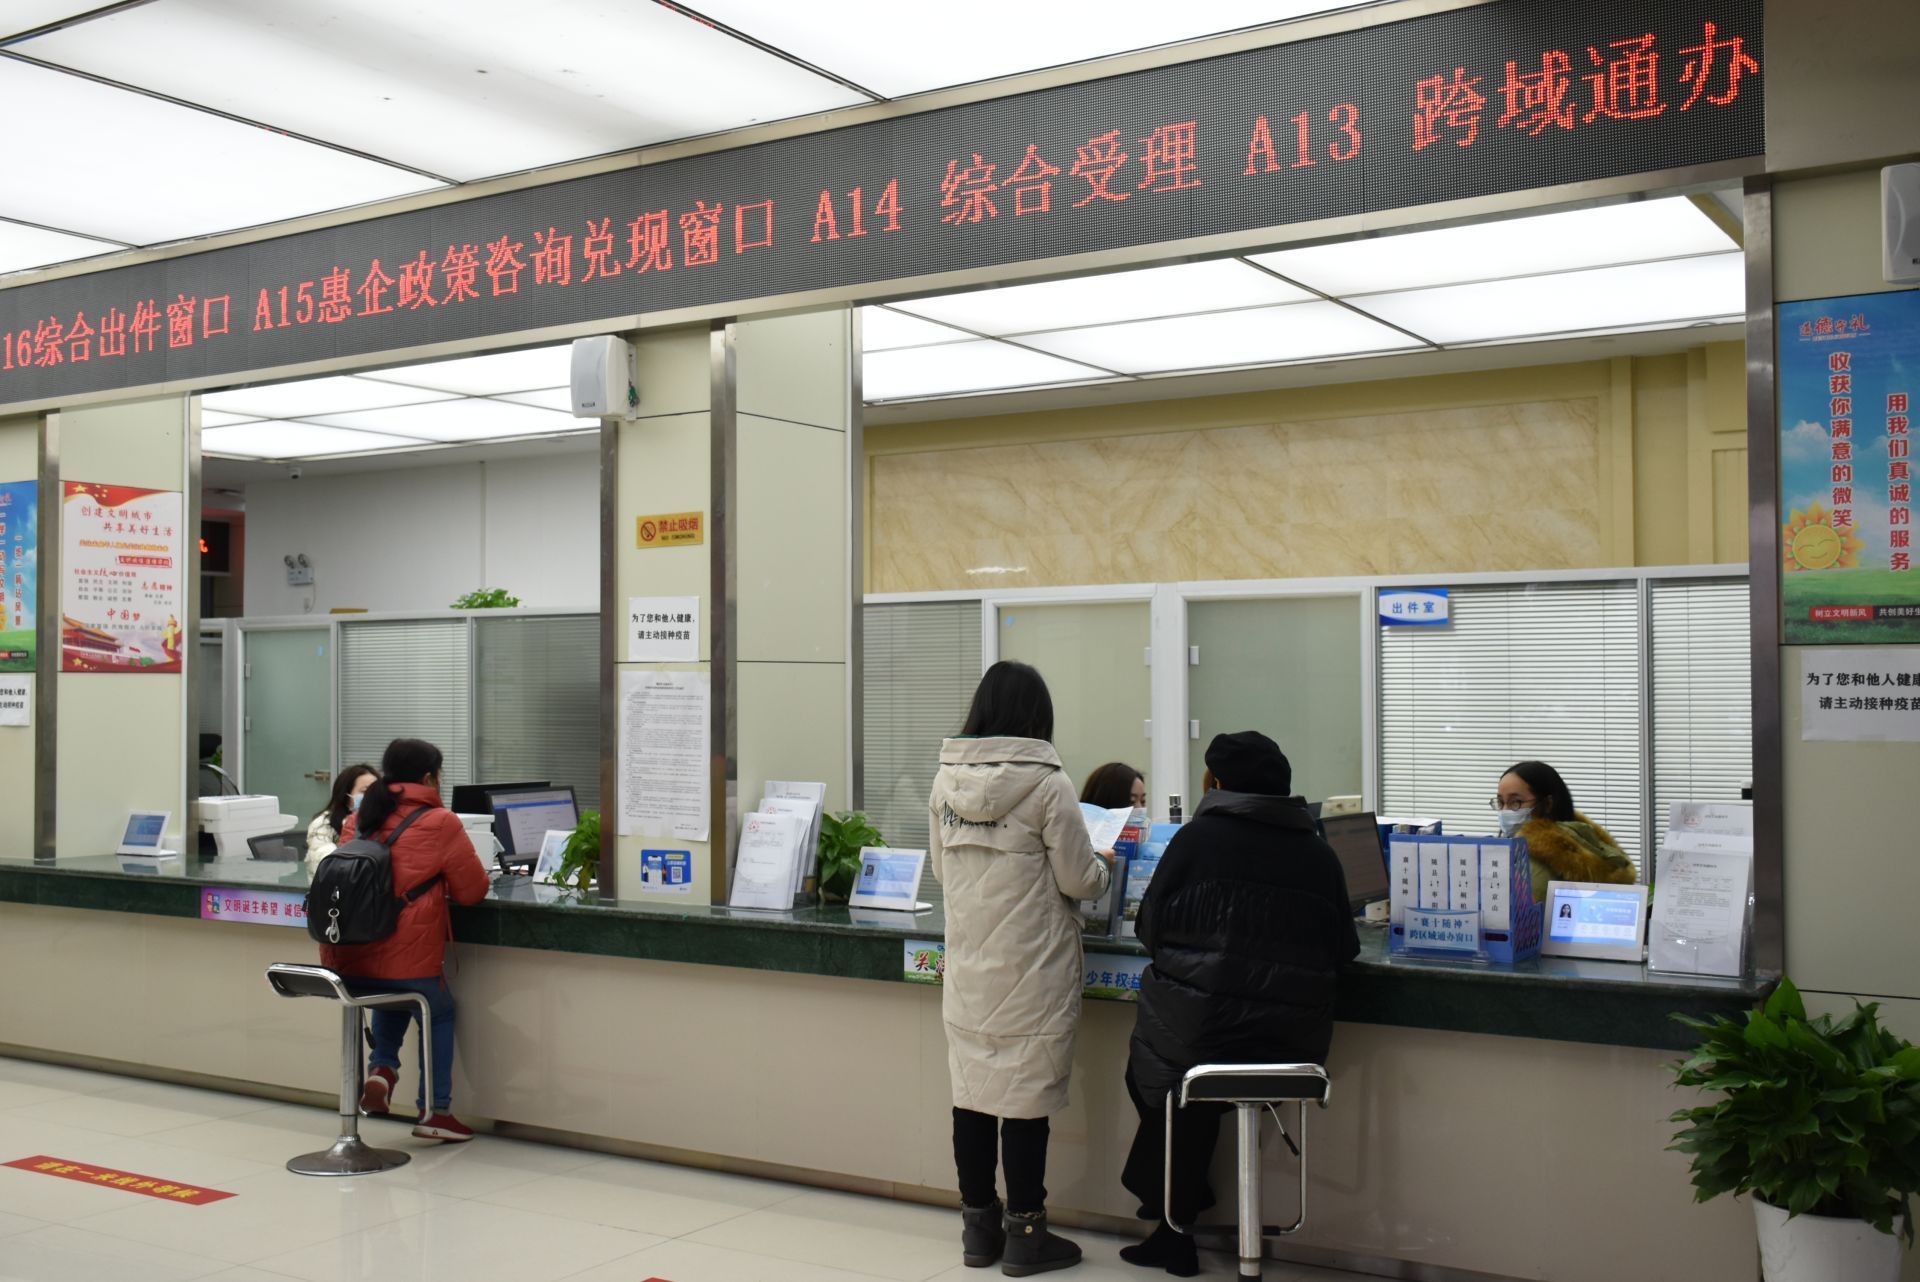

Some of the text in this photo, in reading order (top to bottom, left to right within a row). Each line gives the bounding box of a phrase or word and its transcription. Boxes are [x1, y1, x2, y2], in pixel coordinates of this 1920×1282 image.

[811, 178, 903, 243] A14
[941, 121, 1202, 225] 综合受理
[1243, 103, 1364, 175] A13
[1412, 20, 1760, 151] 跨域通办
[1829, 352, 1852, 527] 收获你满意的微笑
[1887, 393, 1910, 570] 用我们真诚的服务
[658, 518, 699, 533] 禁止吸烟
[1391, 601, 1435, 614] 出件室
[1815, 608, 1867, 617] 树立文明新风
[637, 630, 690, 640] 请主动接种疫苗
[224, 899, 278, 915] 文明诞生希望
[1409, 929, 1474, 943] 跨区域通办窗口
